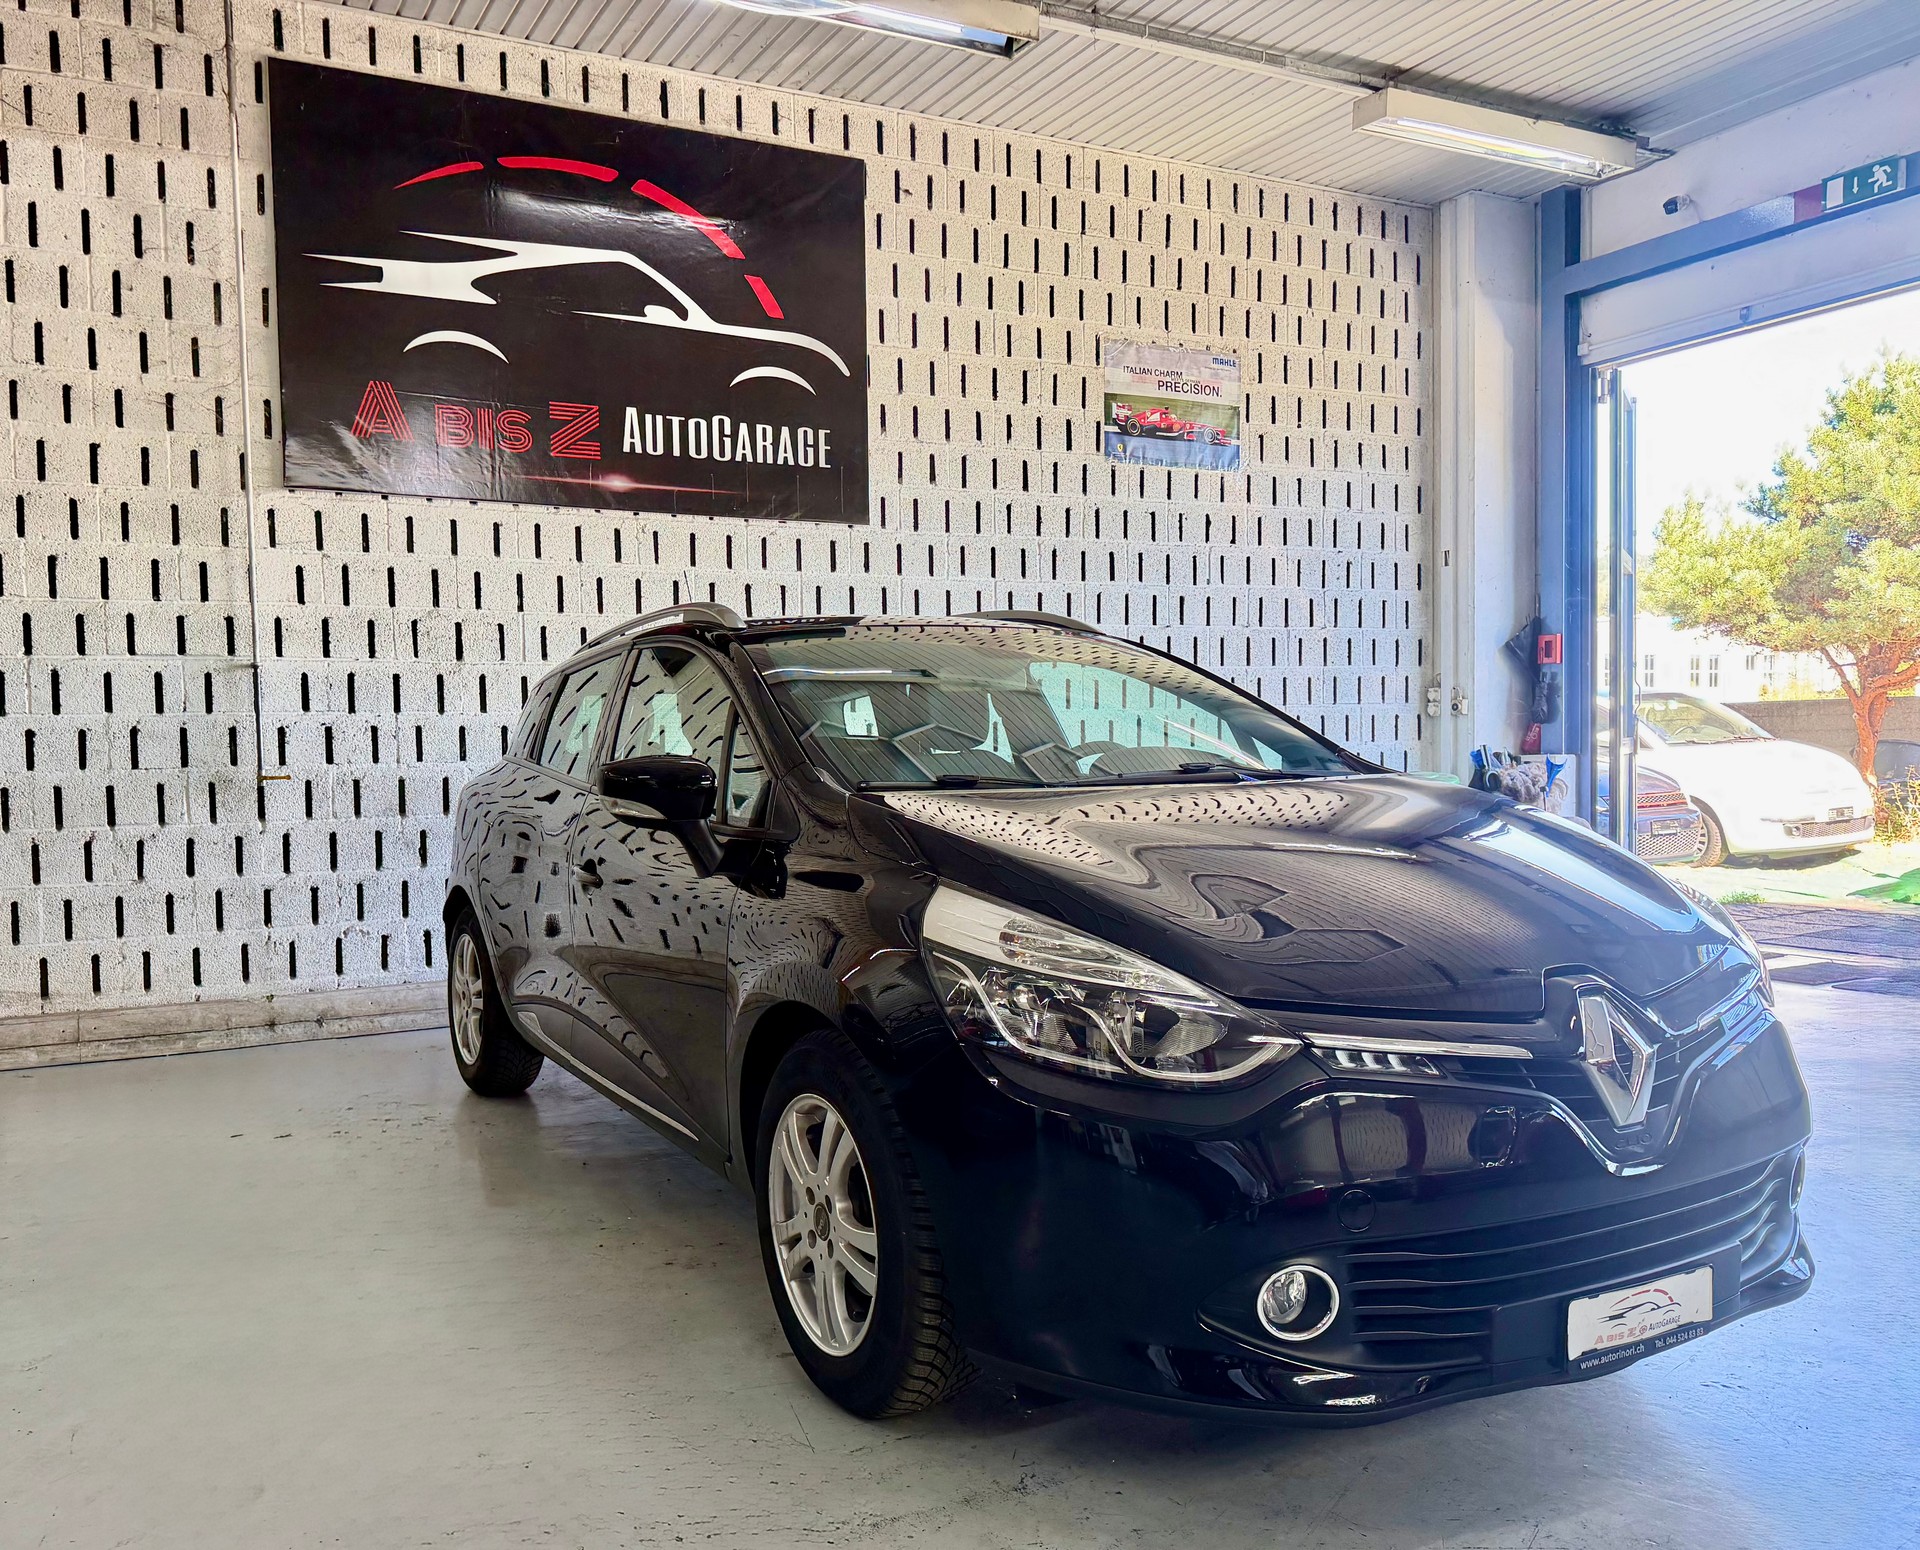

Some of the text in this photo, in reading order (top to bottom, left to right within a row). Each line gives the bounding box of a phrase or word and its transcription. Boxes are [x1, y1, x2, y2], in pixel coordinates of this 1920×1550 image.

[1212, 357, 1237, 368] MAHLE
[1123, 365, 1183, 379] ITALIAN CHARM
[1157, 380, 1222, 397] PRECISION.
[350, 380, 414, 442] A
[434, 404, 533, 453] BIS
[549, 401, 602, 459] Z
[1614, 1133, 1652, 1150] CLIO
[1594, 1334, 1605, 1345] A
[1606, 1332, 1625, 1342] BIS
[1627, 1327, 1637, 1338] Z
[1655, 1338, 1666, 1348] Tel.
[1665, 1335, 1677, 1345] 044
[1677, 1332, 1688, 1342] 524
[1688, 1330, 1696, 1339] 83
[1696, 1327, 1704, 1336] 83
